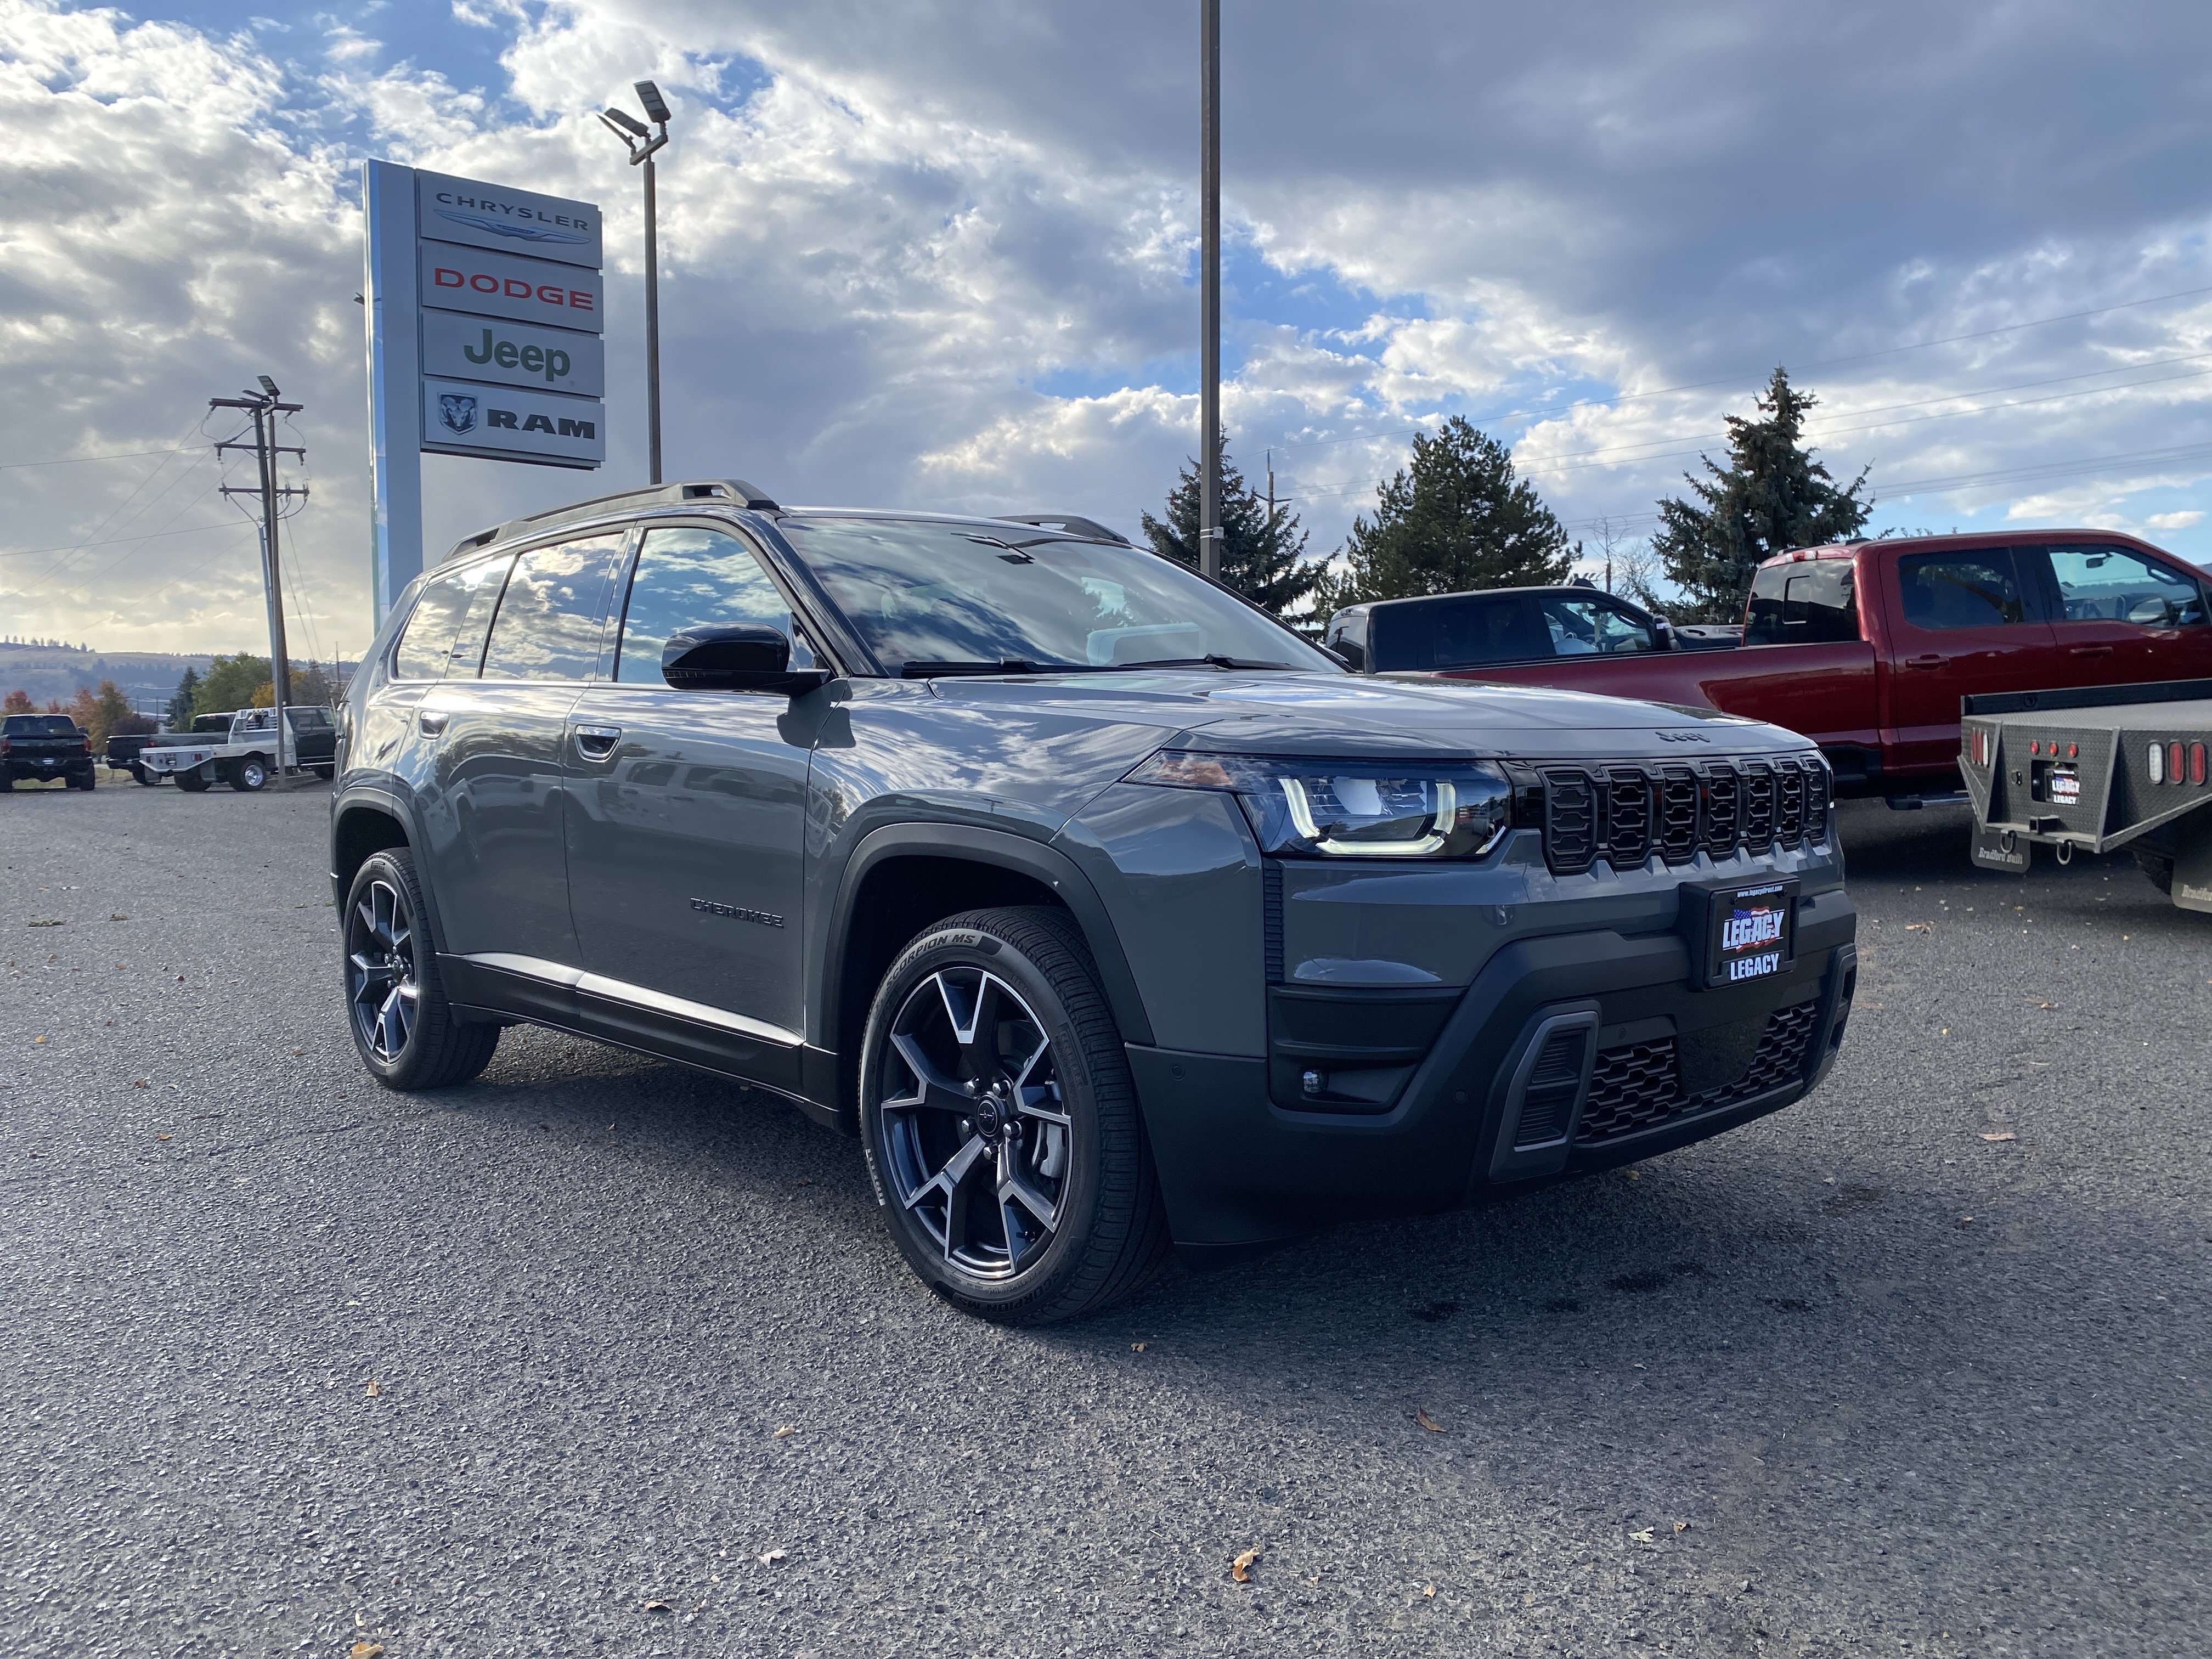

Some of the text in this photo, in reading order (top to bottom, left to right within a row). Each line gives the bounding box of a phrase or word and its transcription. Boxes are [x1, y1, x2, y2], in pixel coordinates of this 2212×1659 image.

[436, 192, 588, 230] CHRYSLER
[434, 267, 594, 311] DODGE
[463, 328, 571, 382] Jeep
[487, 408, 595, 439] RAM
[1655, 731, 1711, 743] Jeep
[2052, 780, 2080, 793] LEGACY
[2053, 795, 2076, 805] LEGACY
[690, 897, 785, 928] CHEROKEE
[1722, 911, 1785, 949] LEGACY
[885, 934, 976, 993] SCORPION MS
[1730, 953, 1780, 980] LEGACY
